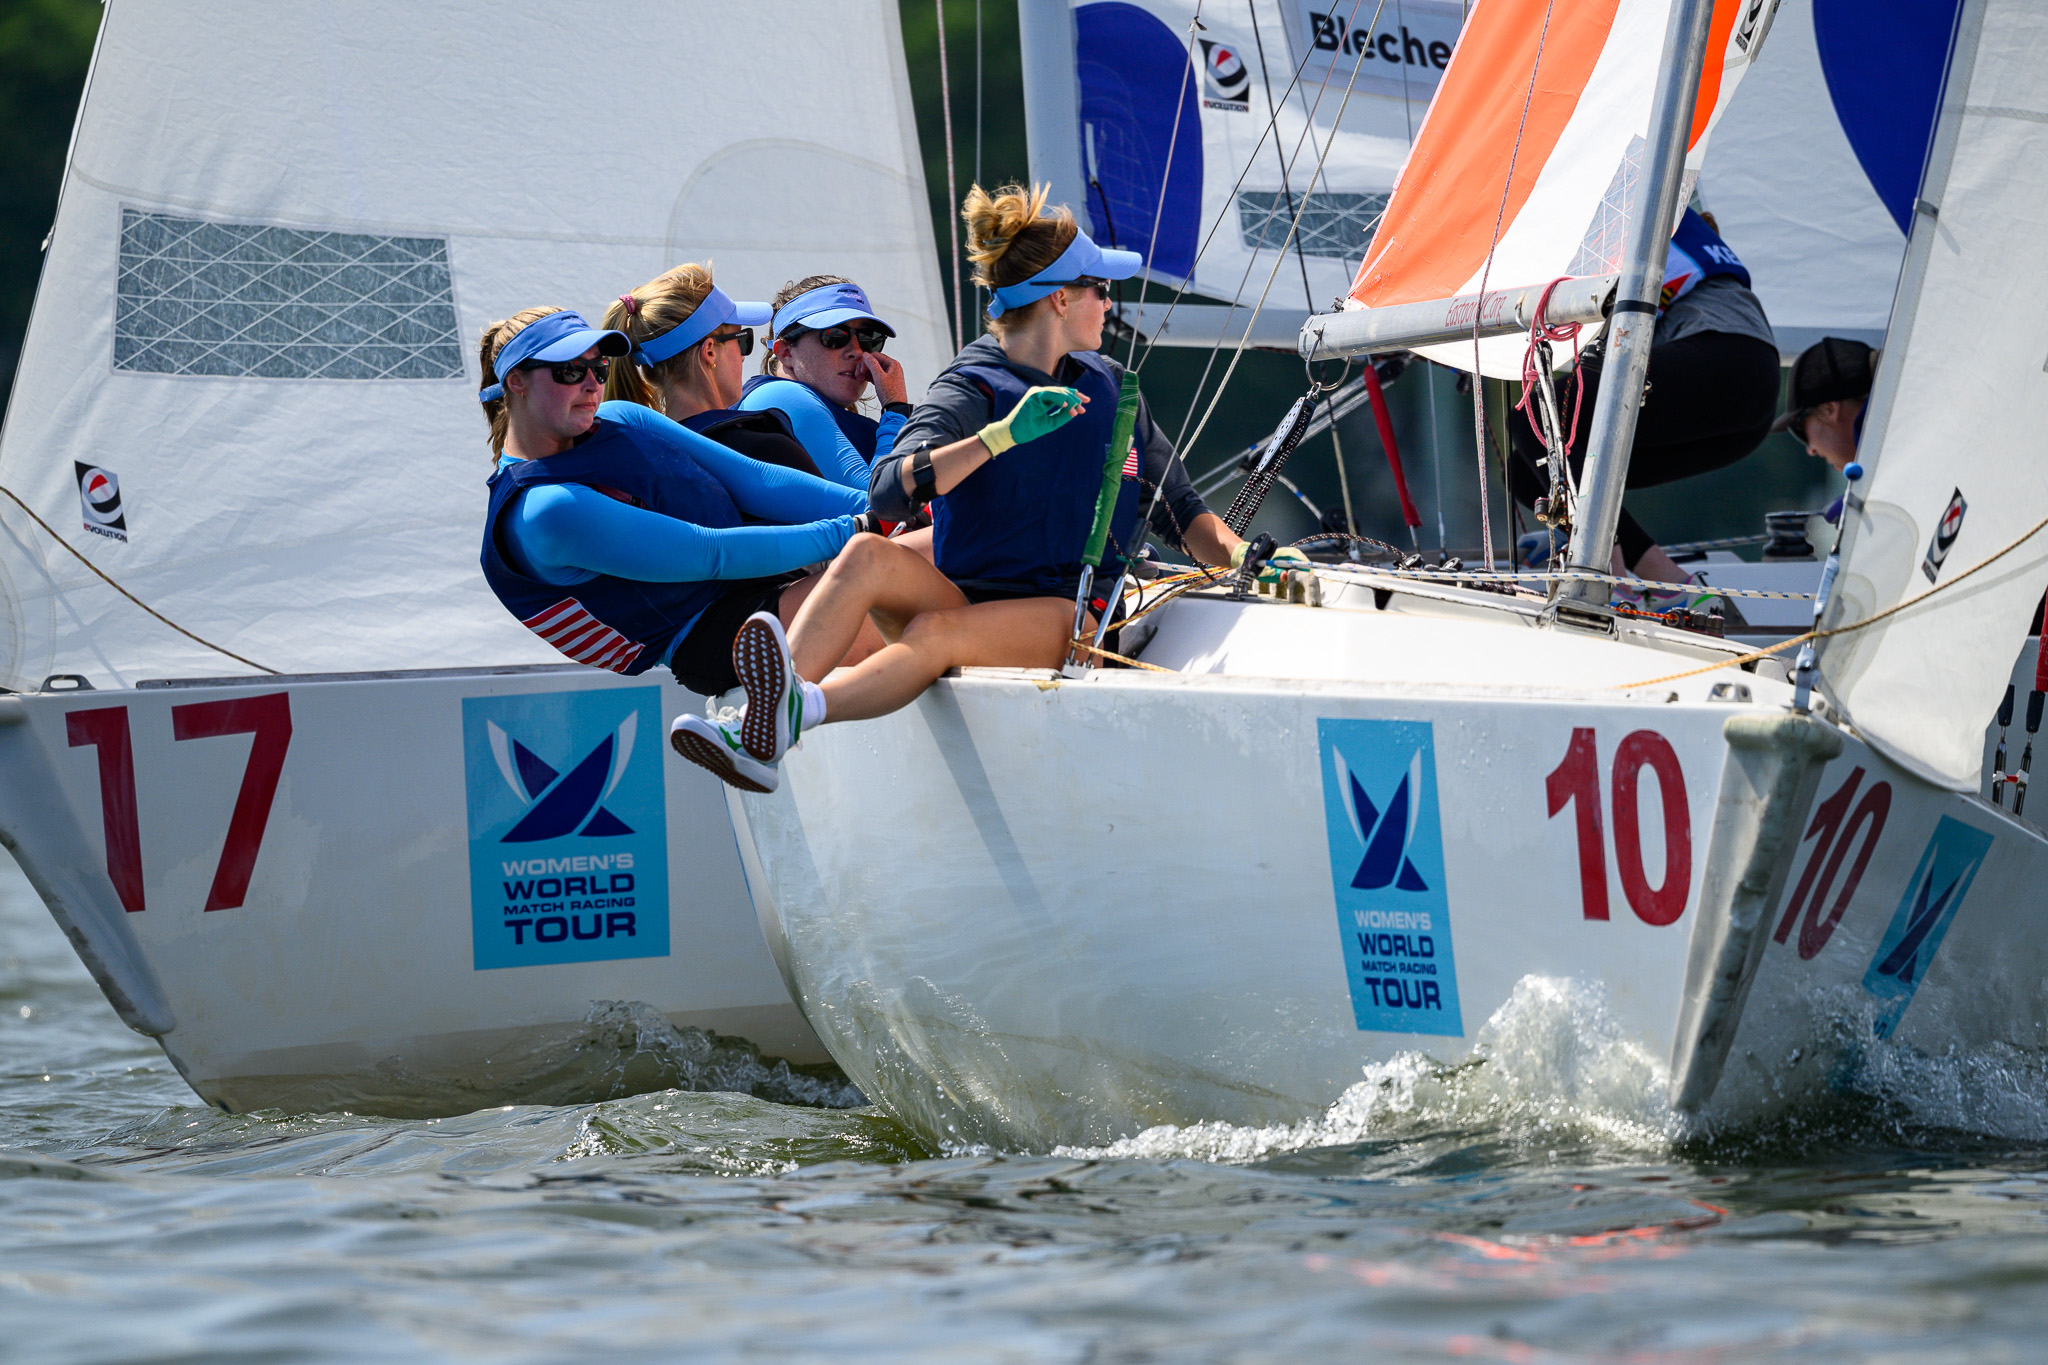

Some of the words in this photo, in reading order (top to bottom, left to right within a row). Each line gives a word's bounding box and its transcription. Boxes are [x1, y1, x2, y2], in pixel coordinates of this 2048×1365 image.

[1309, 11, 1456, 70] Bleche
[65, 692, 293, 913] 17
[1545, 726, 1692, 927] 10
[502, 853, 635, 877] WOMEN'S
[1773, 765, 1893, 961] 10
[503, 873, 635, 900] WORLD
[504, 901, 564, 916] MATCH
[570, 897, 636, 911] RACING
[1354, 910, 1432, 931] WOMEN'S
[504, 911, 637, 945] TOUR
[1357, 932, 1434, 958] WORLD
[1362, 960, 1397, 973] MATCH
[1400, 962, 1437, 976] RACING
[1364, 977, 1442, 1011] TOUR
